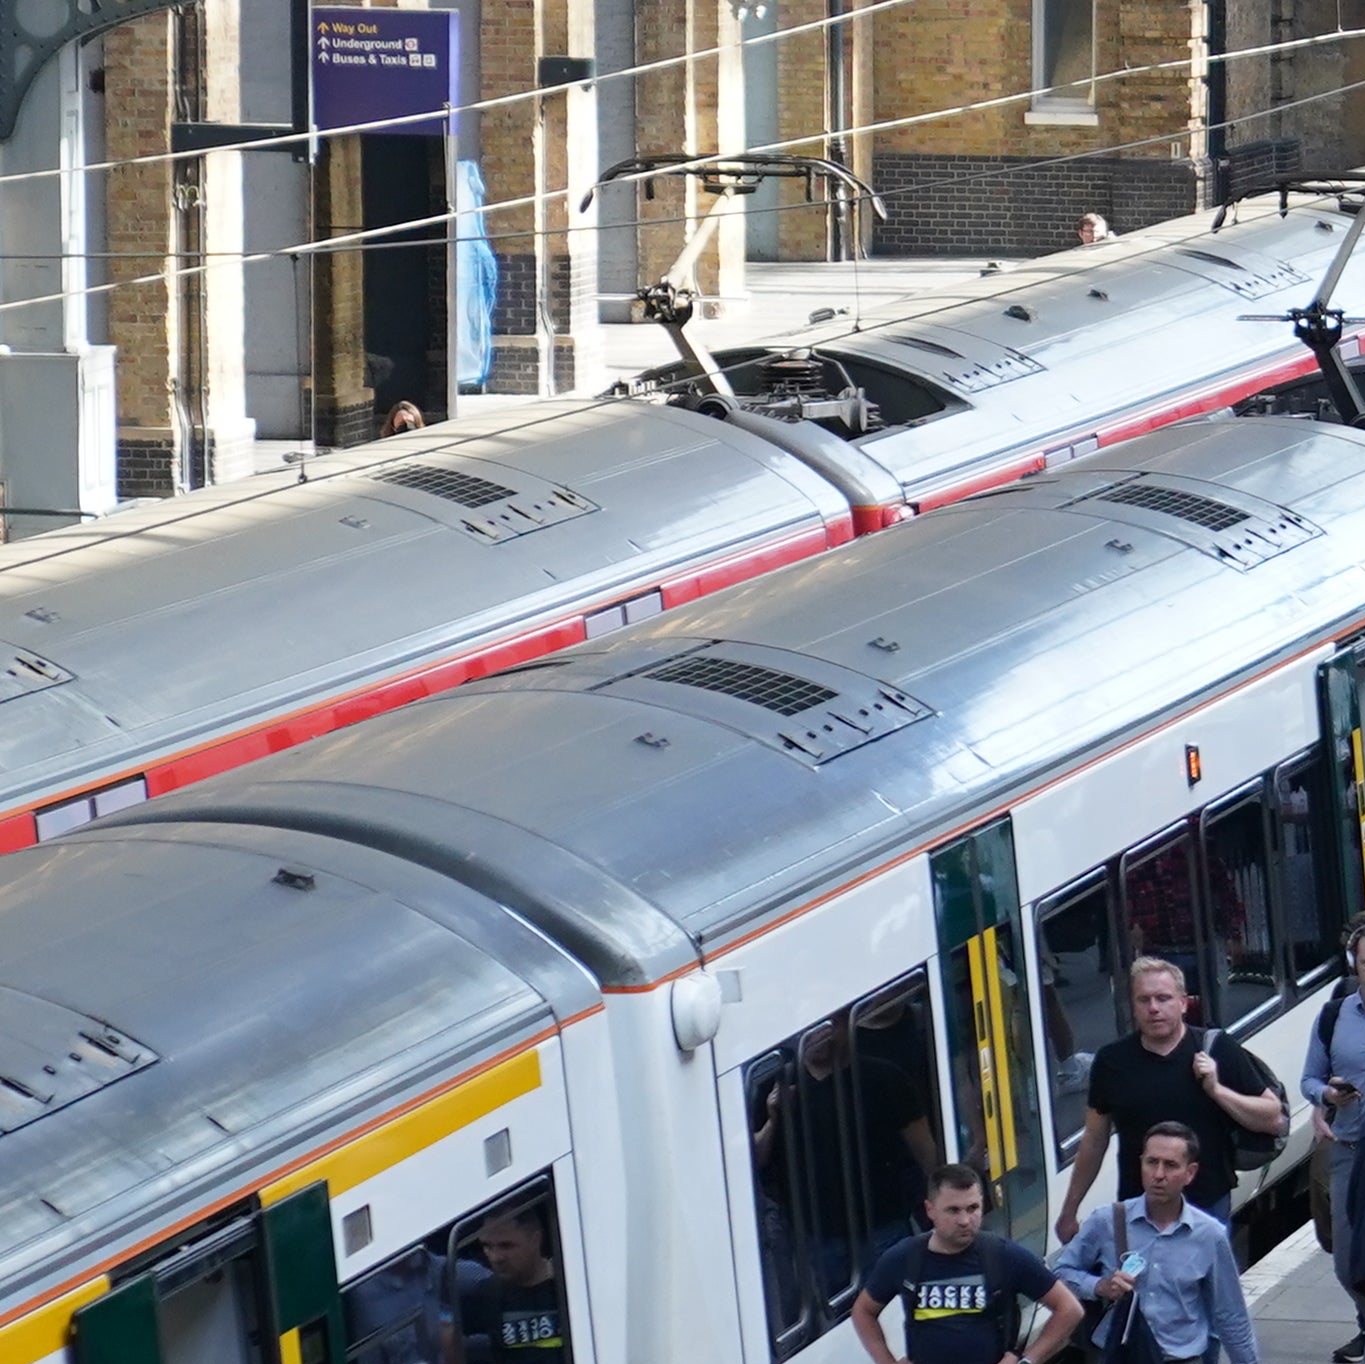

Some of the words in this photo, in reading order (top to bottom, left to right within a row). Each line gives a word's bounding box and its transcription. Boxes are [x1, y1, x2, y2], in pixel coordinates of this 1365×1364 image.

[332, 23, 355, 35] Way
[357, 23, 378, 34] Out
[332, 38, 402, 51] Underground
[332, 53, 366, 64] Buses
[368, 53, 377, 64] &
[379, 54, 407, 65] Taxis
[917, 1297, 986, 1309] JONES
